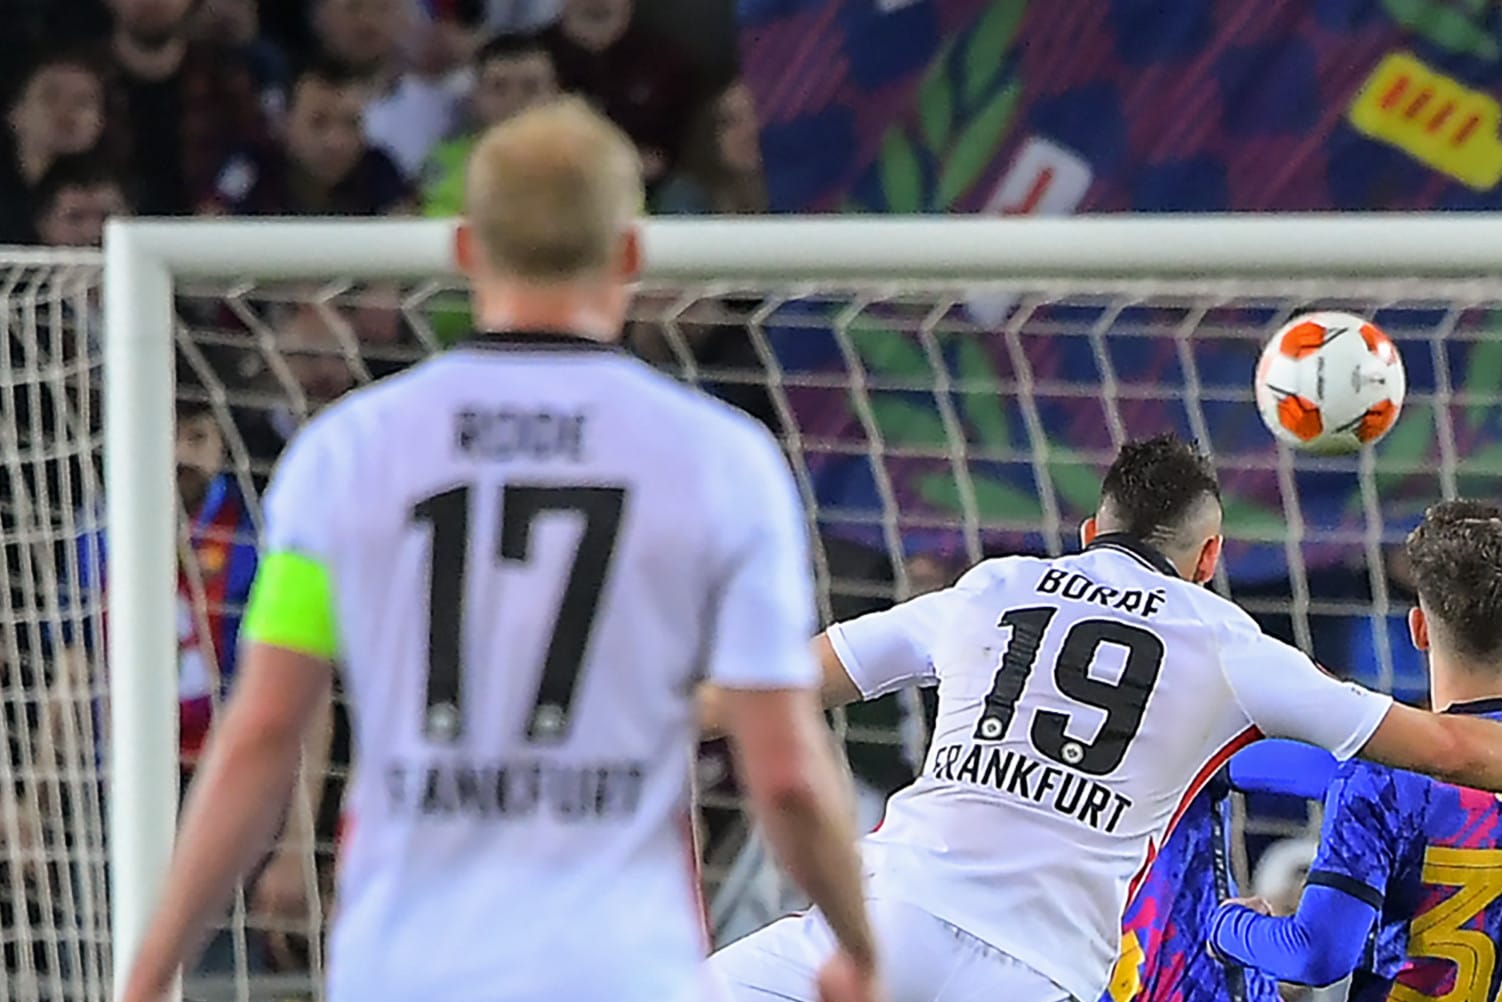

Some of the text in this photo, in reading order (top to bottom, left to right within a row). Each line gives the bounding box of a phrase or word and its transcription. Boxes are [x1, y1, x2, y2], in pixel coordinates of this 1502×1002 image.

[411, 485, 626, 742] 17
[973, 606, 1165, 776] 19
[932, 743, 1132, 833] FRANKFURT
